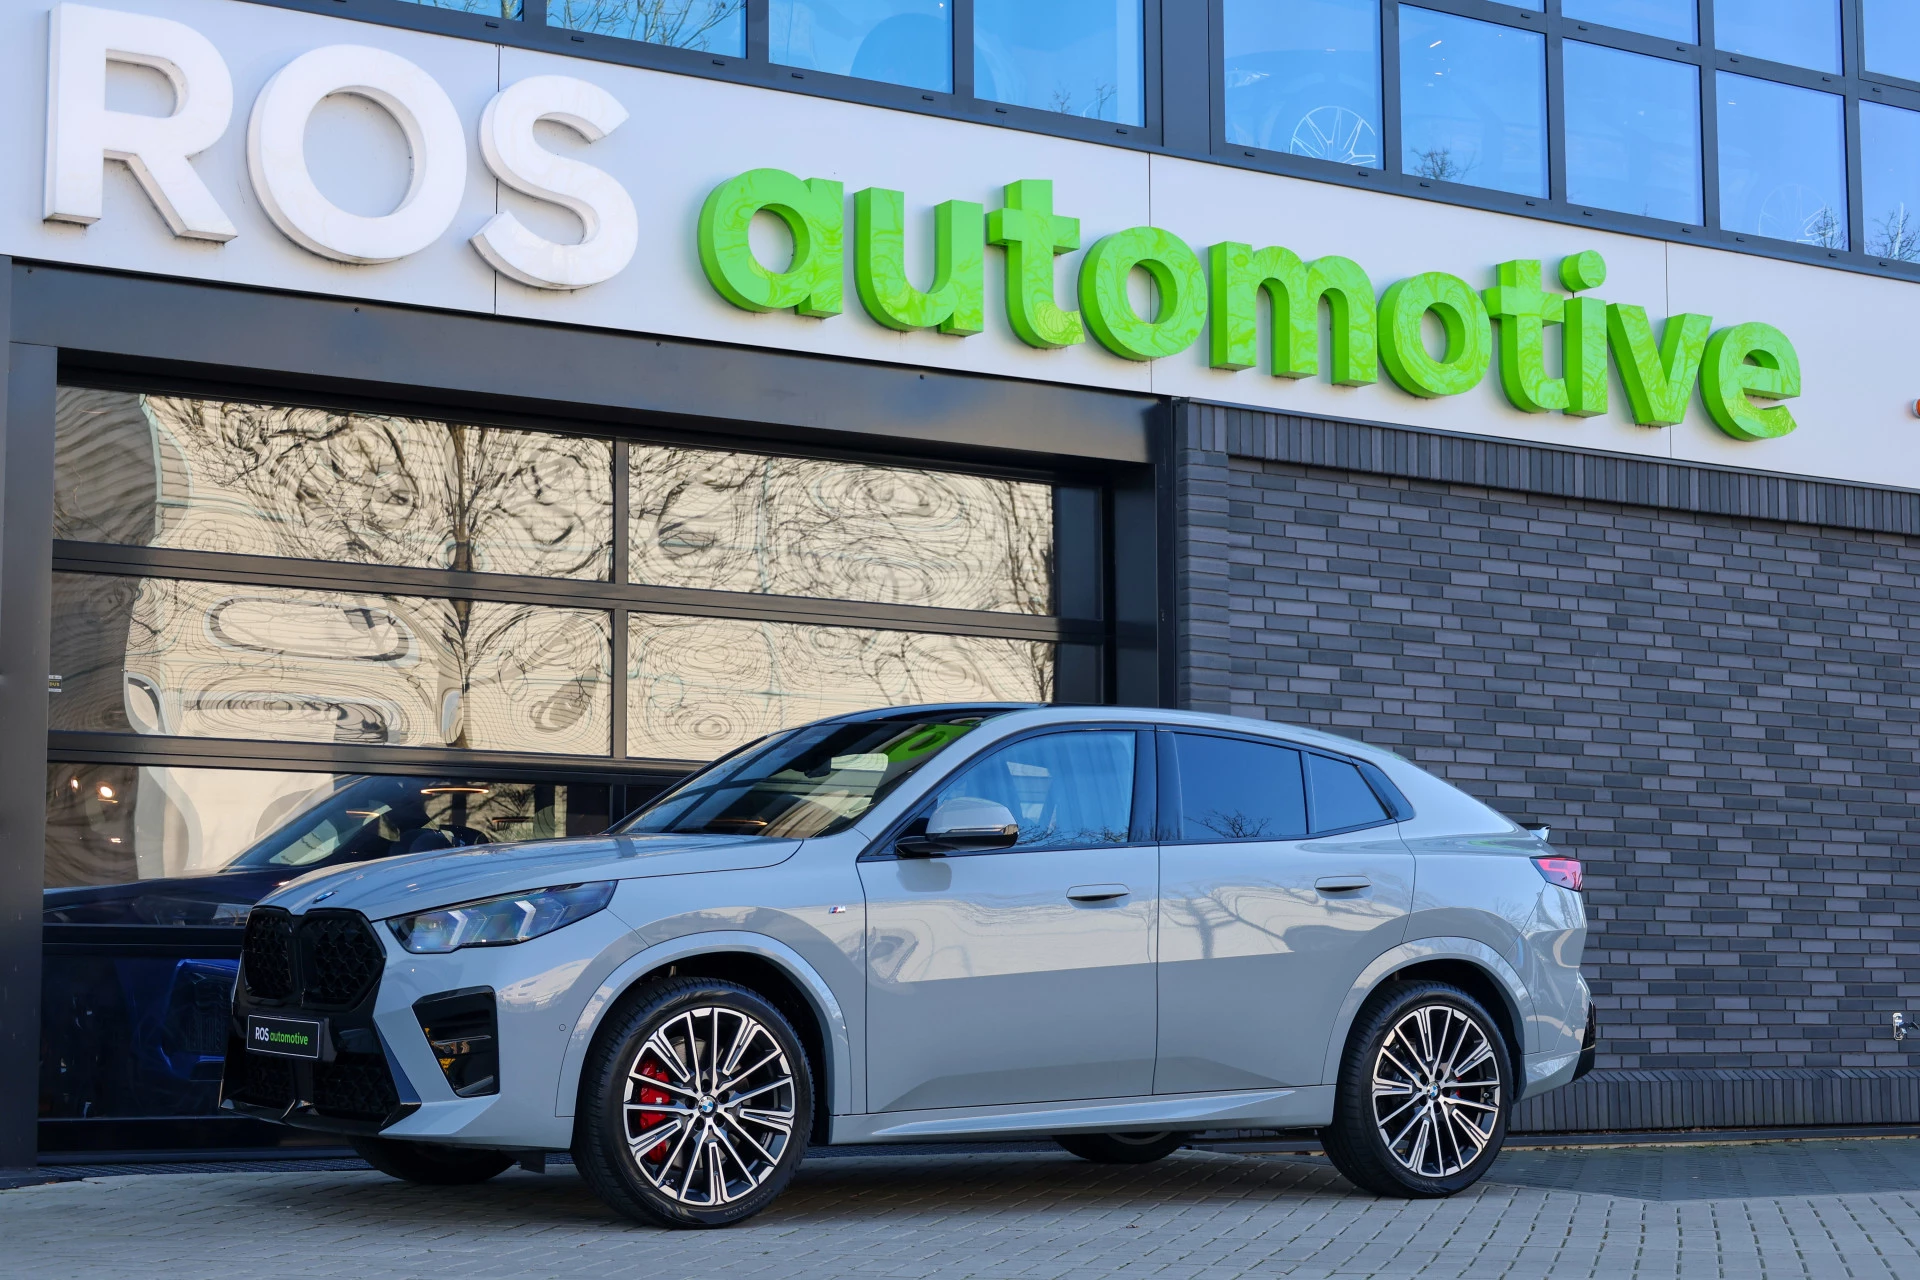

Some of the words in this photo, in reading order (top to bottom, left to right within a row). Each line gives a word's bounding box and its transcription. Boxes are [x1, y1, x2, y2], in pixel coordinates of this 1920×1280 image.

[43, 3, 639, 291] ROS
[697, 168, 1801, 442] automotive
[255, 1026, 270, 1042] ROS
[270, 1031, 309, 1046] automotive
